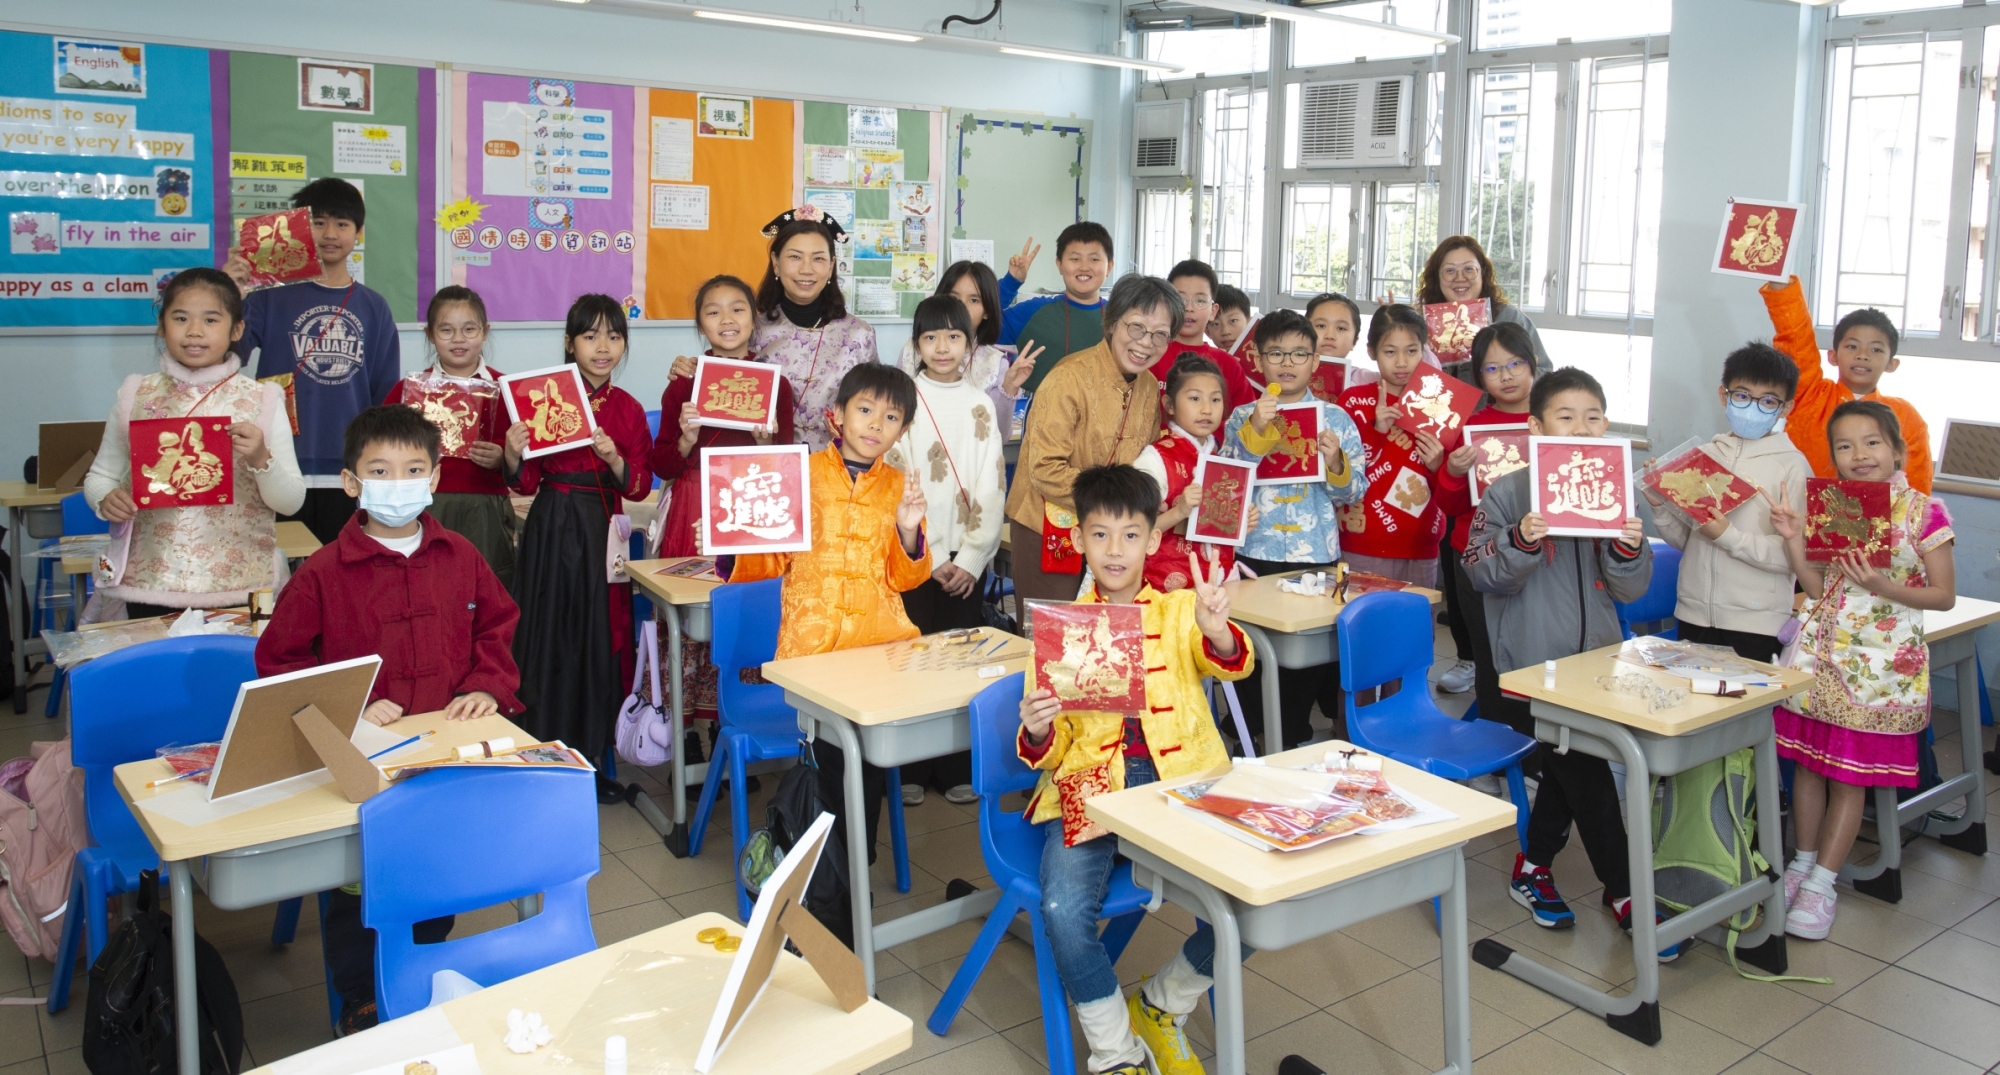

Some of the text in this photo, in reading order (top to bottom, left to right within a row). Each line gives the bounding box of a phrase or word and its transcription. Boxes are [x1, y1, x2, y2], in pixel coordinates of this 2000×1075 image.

[74, 56, 119, 70] English
[320, 85, 352, 100] 數學
[63, 106, 84, 121] to
[94, 112, 127, 128] say
[713, 109, 737, 122] 視藝
[3, 130, 185, 157] you're very happy
[232, 158, 305, 174] 解難策略
[4, 180, 50, 192] over
[58, 178, 92, 194] the
[544, 208, 559, 216] 人文
[66, 225, 196, 245] fly in the air
[454, 229, 632, 250] 國情時事資訊站
[51, 281, 73, 292] as
[83, 282, 94, 292] a
[105, 277, 148, 293] clam
[294, 305, 364, 333] IMPORTER EXPORTER
[293, 334, 364, 363] VALUABLE
[1371, 499, 1398, 533] BRMG
